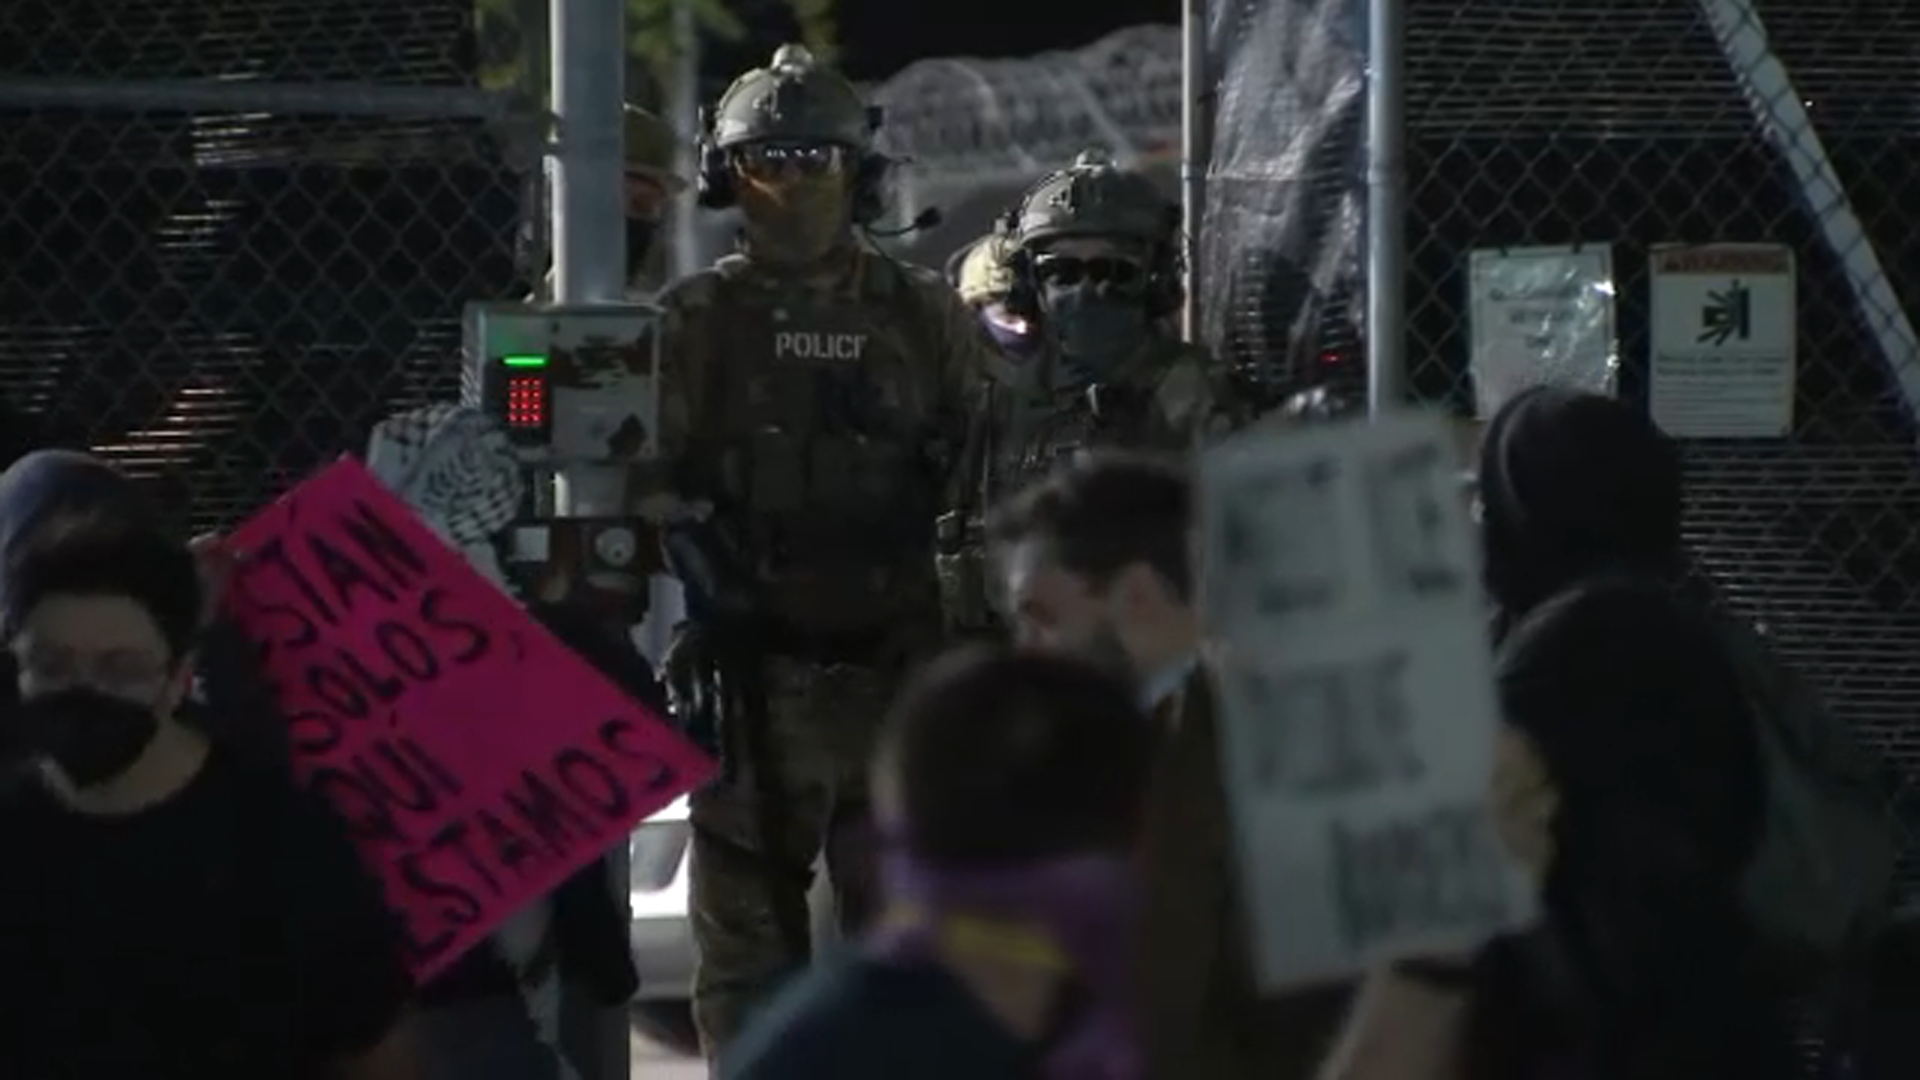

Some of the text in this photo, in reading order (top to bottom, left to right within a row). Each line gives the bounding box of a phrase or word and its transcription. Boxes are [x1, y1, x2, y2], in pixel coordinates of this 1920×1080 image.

[774, 332, 867, 359] POLICE
[237, 499, 428, 656] STÁN
[310, 712, 463, 842] QUÍ
